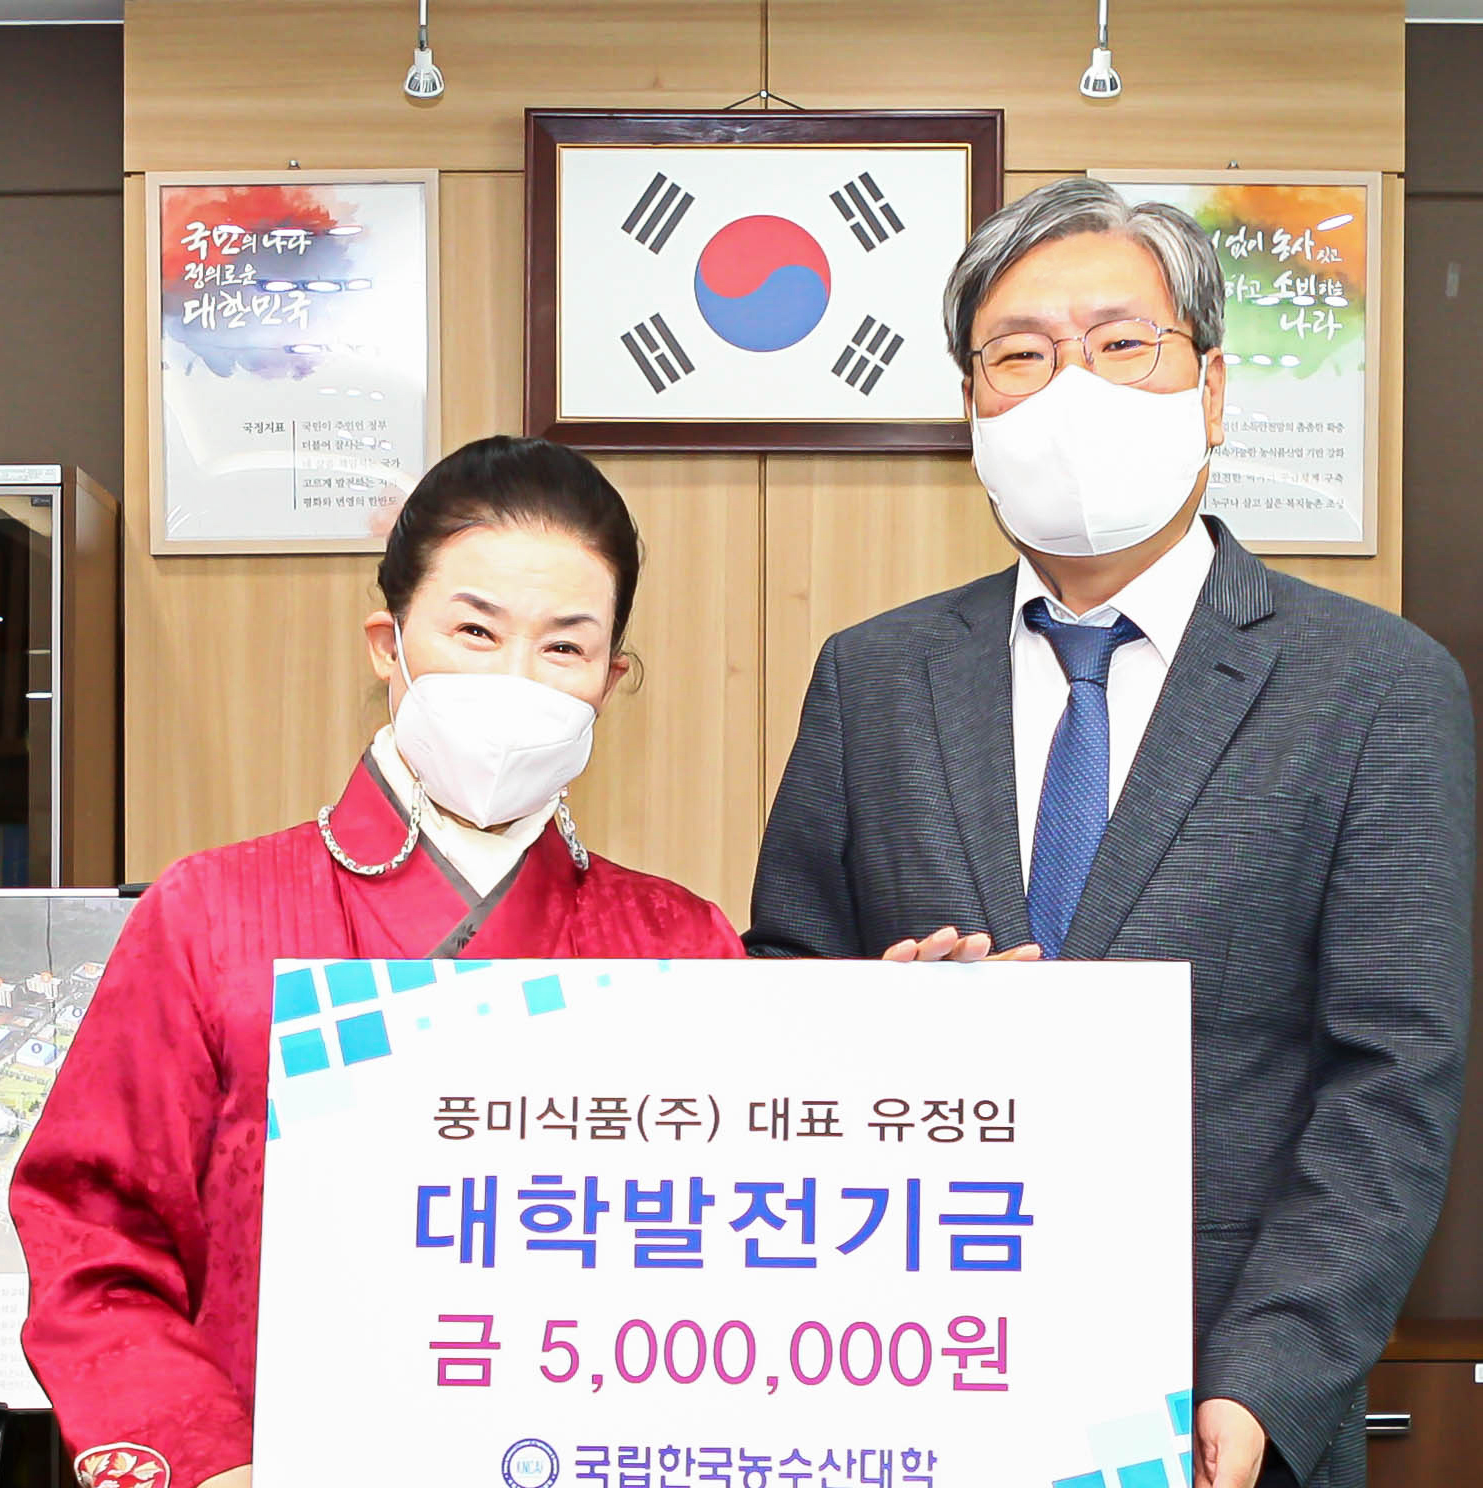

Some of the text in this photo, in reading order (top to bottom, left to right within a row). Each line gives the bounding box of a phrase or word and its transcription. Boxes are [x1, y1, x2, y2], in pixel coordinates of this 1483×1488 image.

[180, 221, 257, 261] 국민의
[1270, 227, 1315, 262] 농사
[184, 262, 257, 289] 정의로운
[183, 290, 312, 331] 대한민국
[1279, 306, 1343, 341] 나라
[242, 421, 286, 434] 국정지표
[433, 1094, 1016, 1144] 풍미식품(주) 대표 유정임
[415, 1174, 1035, 1273] 대학발전기금
[428, 1313, 1010, 1396] 금 5,000,000원
